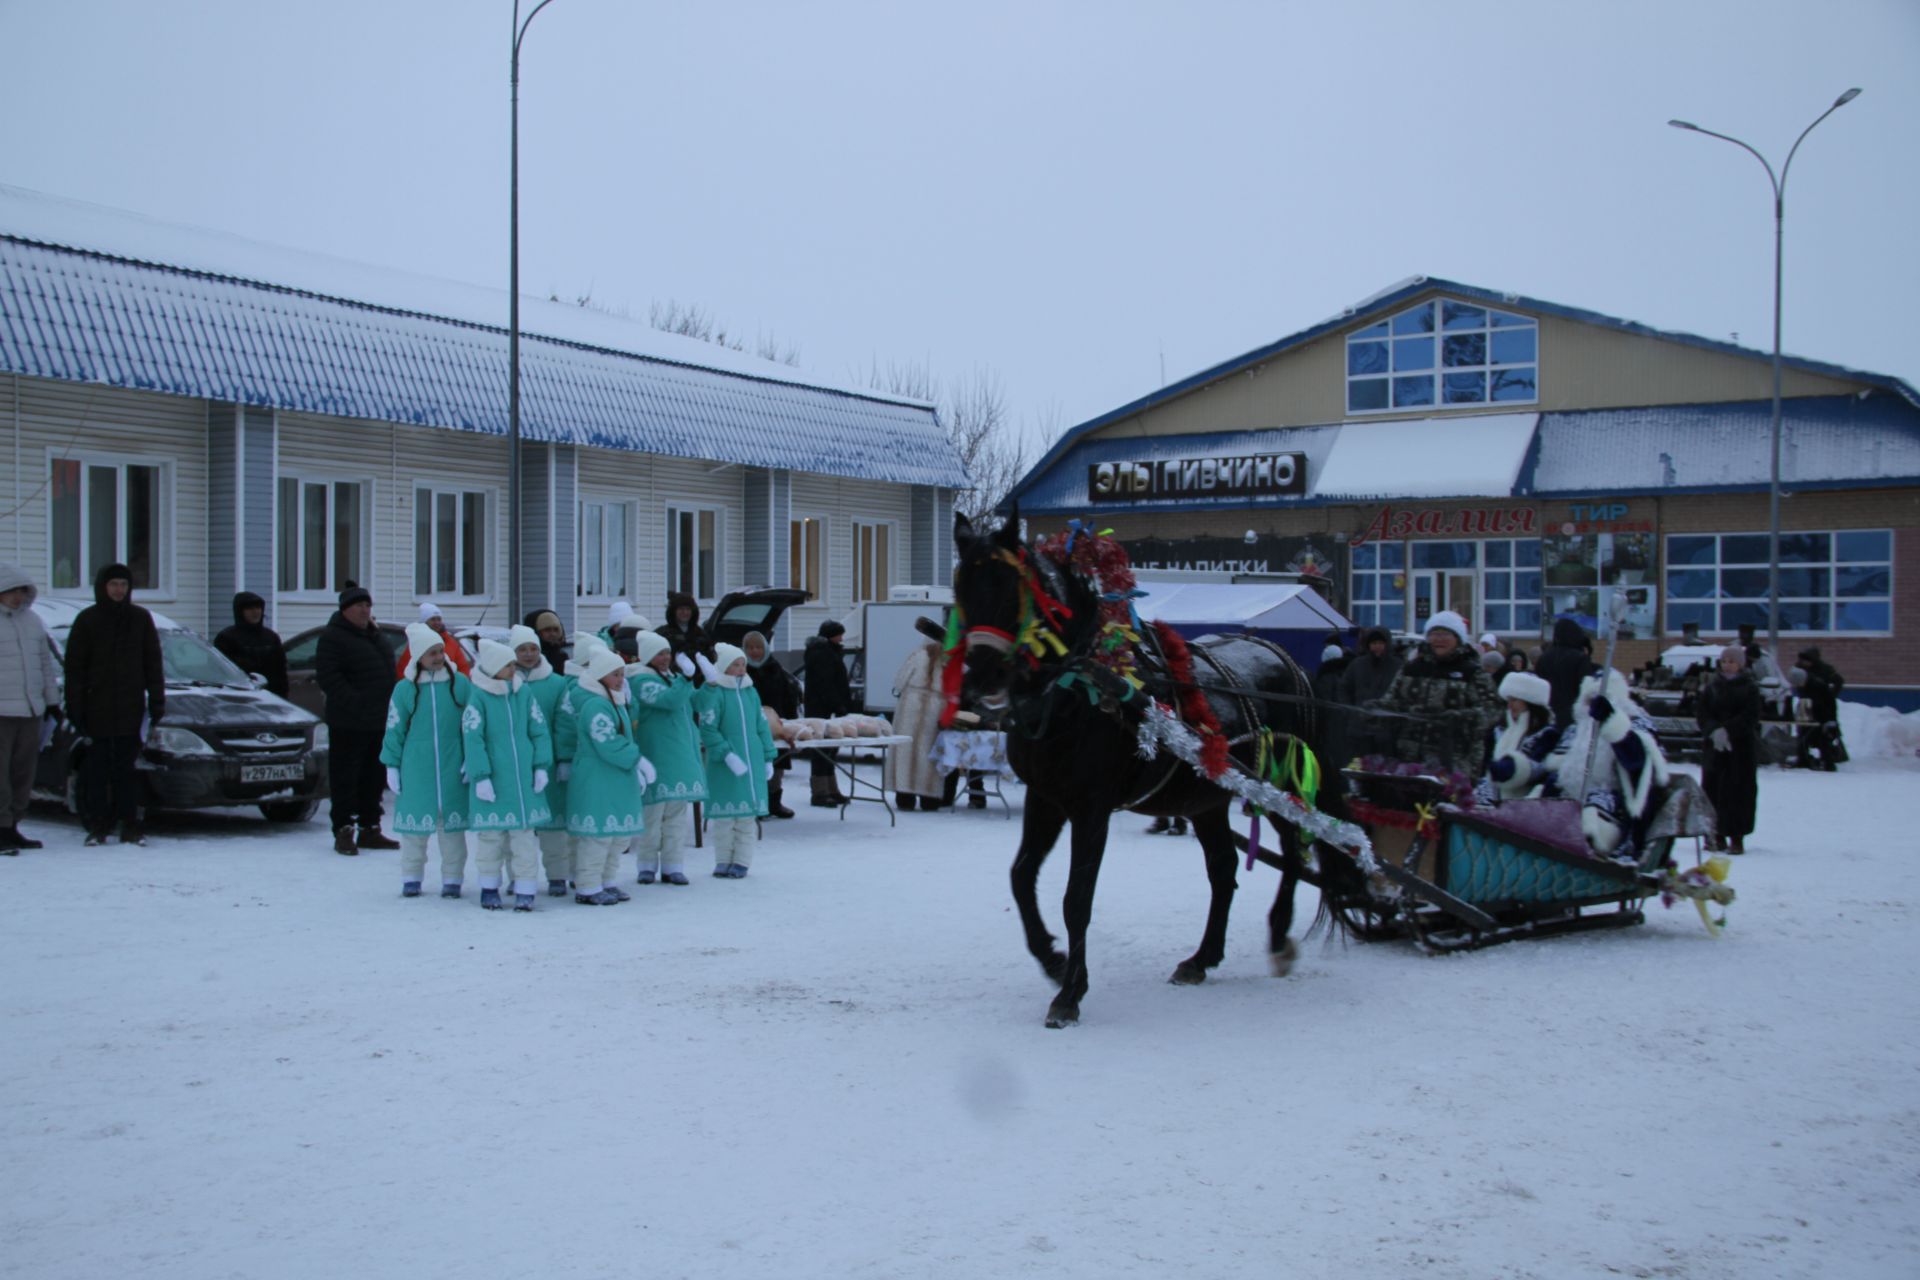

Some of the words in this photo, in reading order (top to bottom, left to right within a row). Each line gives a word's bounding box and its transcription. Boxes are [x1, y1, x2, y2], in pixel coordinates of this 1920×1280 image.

[1096, 462, 1150, 493] ЭЛЬ
[1164, 454, 1296, 491] ПИВЧИНО
[1350, 504, 1536, 547] Азалия
[1569, 504, 1629, 520] ТИР
